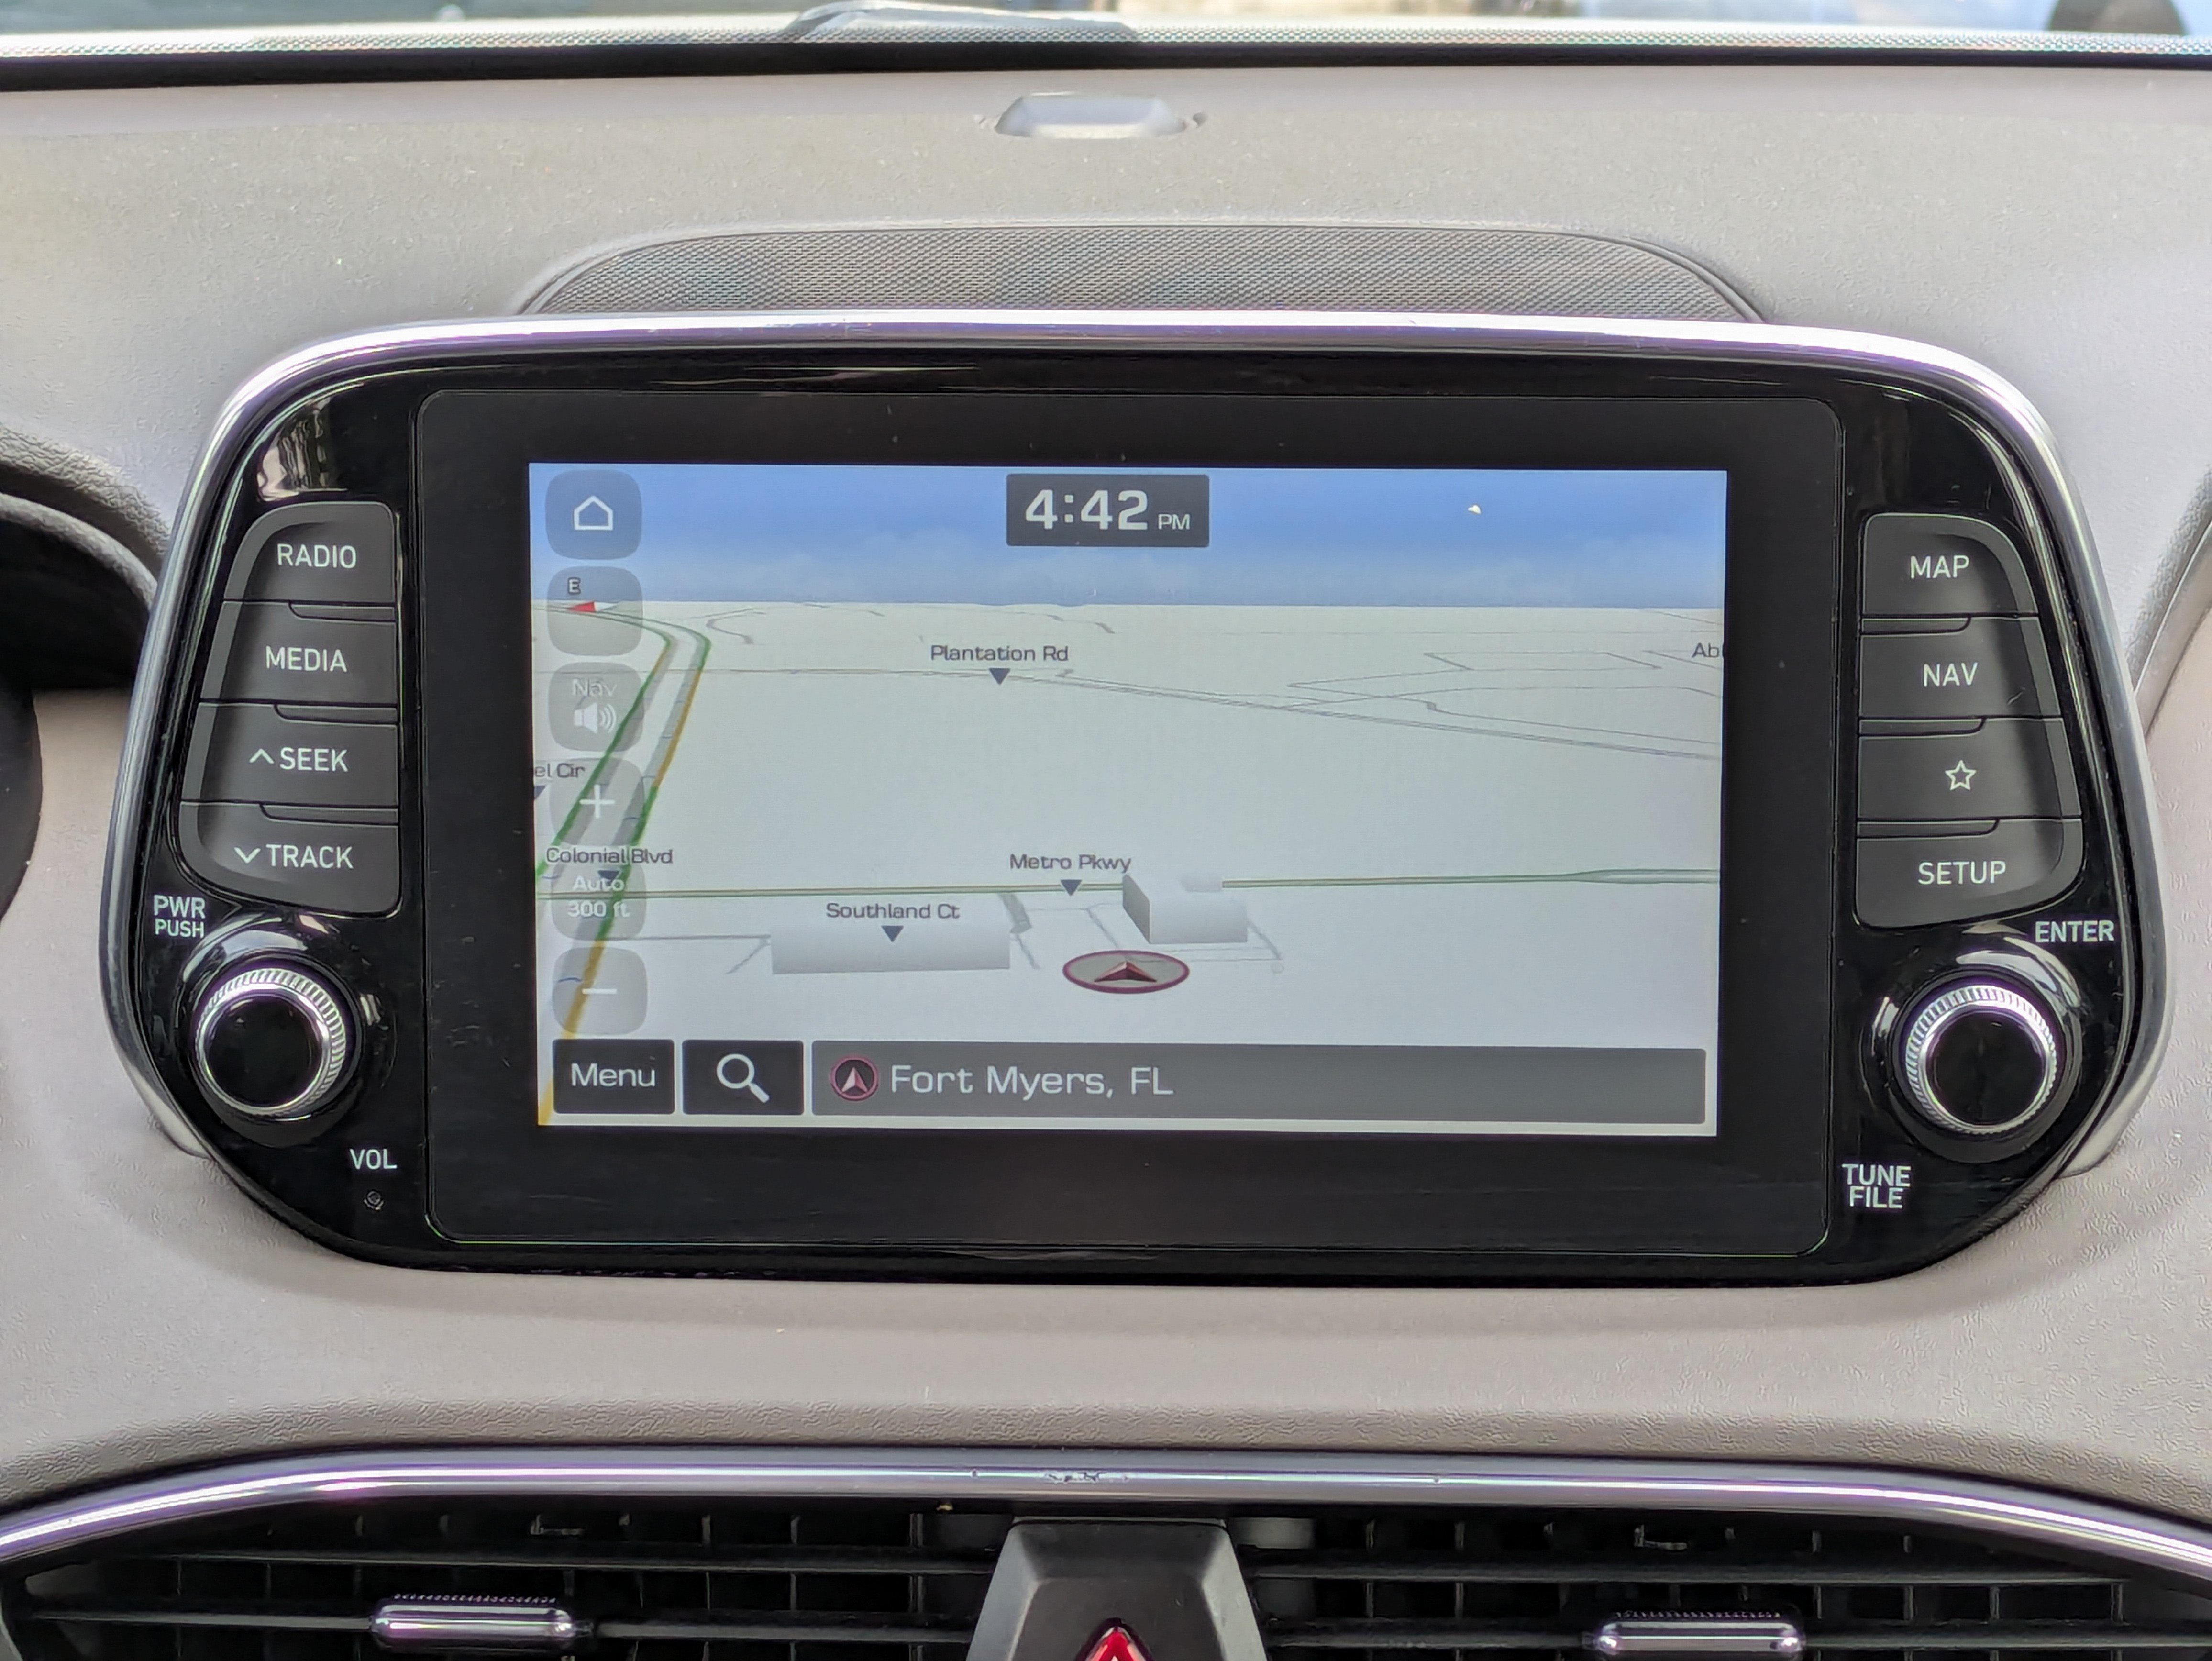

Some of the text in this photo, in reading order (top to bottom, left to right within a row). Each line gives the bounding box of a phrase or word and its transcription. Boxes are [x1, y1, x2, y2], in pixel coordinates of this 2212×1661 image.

[1025, 489, 1190, 530] 4:42 PM
[276, 543, 357, 569] RADIO
[1909, 554, 1969, 579] MAP
[567, 577, 581, 595] E
[265, 646, 347, 672] MEDIA
[930, 645, 1069, 661] Plantation Rd
[1692, 642, 1720, 658] Ab
[1923, 662, 1978, 687] NAV
[572, 678, 617, 696] Nav
[280, 747, 348, 772] SEEK
[556, 763, 586, 778] Cir
[265, 844, 353, 869] TRACK
[546, 847, 674, 864] Colonial Blvd
[1009, 854, 1131, 874] Metro Pkwy
[572, 875, 625, 891] Auto
[1918, 861, 2006, 885] SETUP
[153, 894, 206, 919] PWR
[567, 901, 630, 917] 300 ft
[826, 903, 960, 919] Southland Ct
[155, 918, 205, 938] PUSH
[2035, 919, 2115, 943] ENTER
[571, 1063, 655, 1087] Menu
[891, 1065, 1174, 1100] Fort Myers, FL
[349, 1148, 398, 1170] VOL
[1842, 1163, 1911, 1187] TUNE
[1849, 1186, 1904, 1209] FILE
